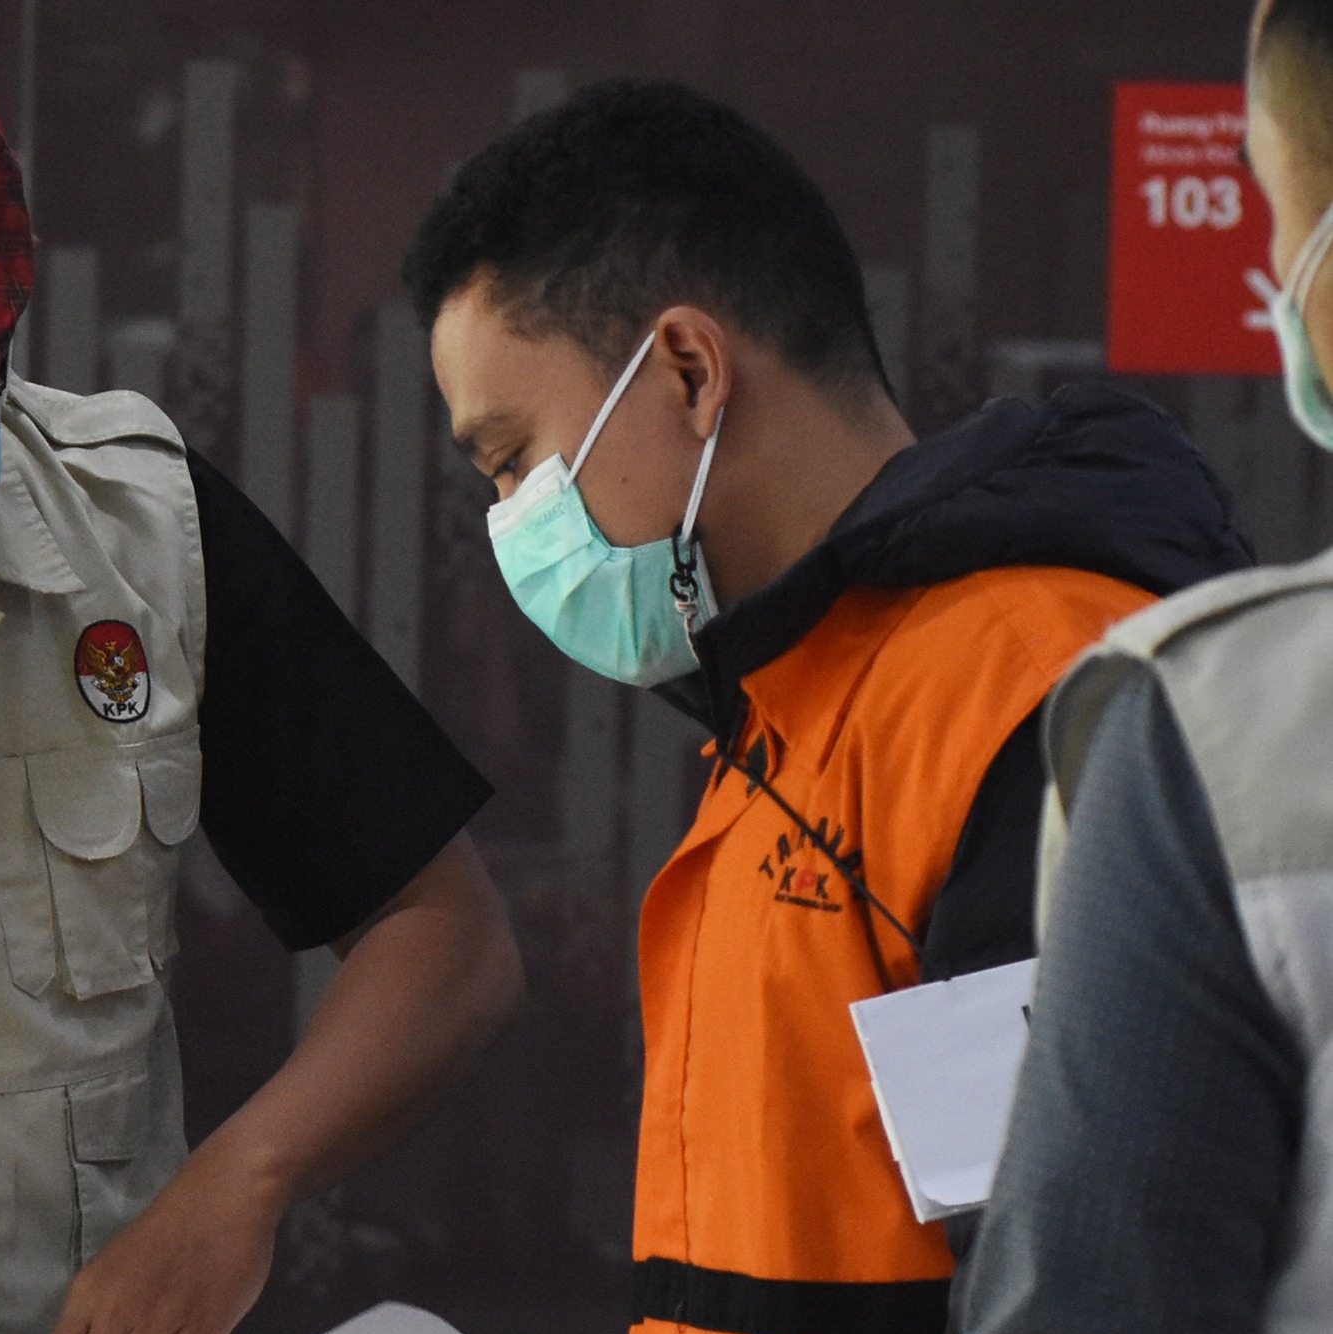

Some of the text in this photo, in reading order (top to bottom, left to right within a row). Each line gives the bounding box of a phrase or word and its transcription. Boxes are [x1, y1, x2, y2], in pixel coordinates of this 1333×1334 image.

[1142, 174, 1243, 230] 103
[103, 702, 140, 717] KPK
[778, 866, 830, 899] KPK
